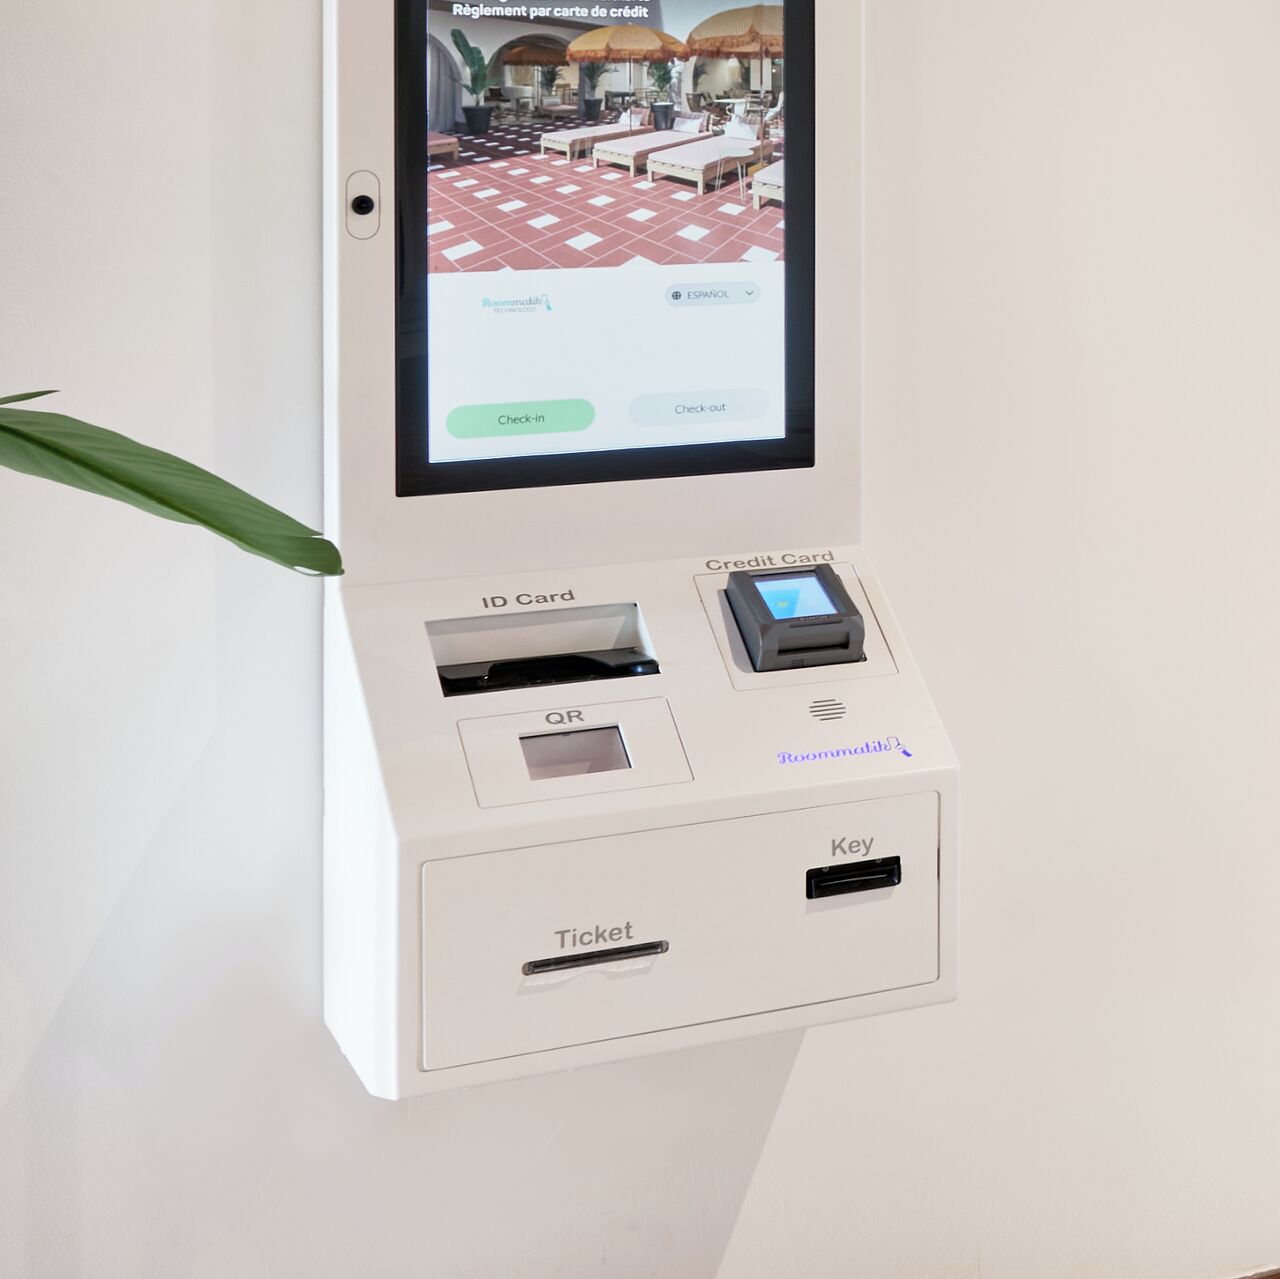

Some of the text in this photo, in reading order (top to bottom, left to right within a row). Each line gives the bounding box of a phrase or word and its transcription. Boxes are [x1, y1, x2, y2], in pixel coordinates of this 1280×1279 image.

[452, 3, 649, 19] Règlement par carte de crédit
[687, 288, 730, 300] ESPAÑOL
[674, 401, 726, 414] Check-out
[498, 413, 545, 426] Check-in
[705, 550, 836, 572] Credit Card
[481, 588, 576, 610] ID Card
[544, 709, 585, 727] QR
[777, 740, 889, 766] Roommatik
[830, 835, 876, 860] Key
[554, 921, 634, 950] Ticket
